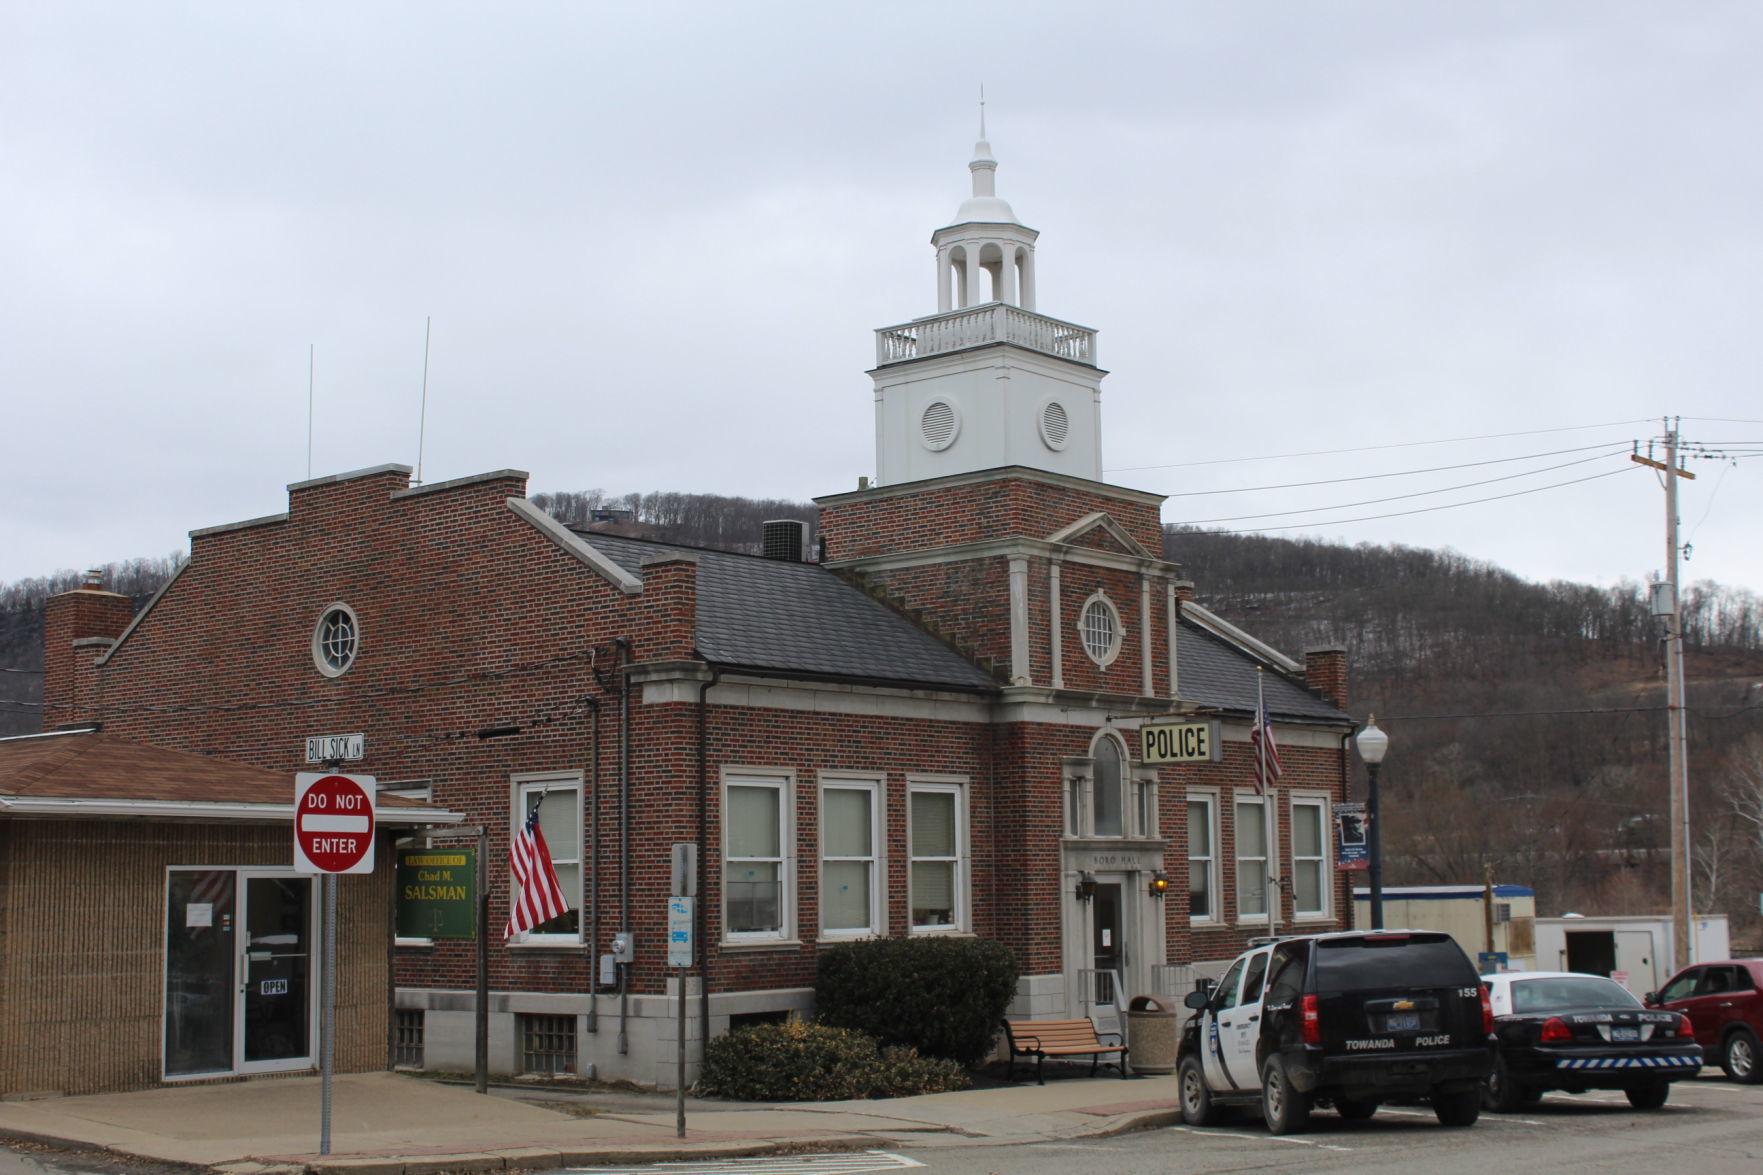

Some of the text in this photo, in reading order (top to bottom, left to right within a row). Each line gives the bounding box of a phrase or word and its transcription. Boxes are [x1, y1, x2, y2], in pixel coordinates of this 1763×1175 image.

[309, 738, 360, 760] BILL SICK LN
[1146, 727, 1206, 759] POLICE
[308, 793, 363, 809] DO NOT
[312, 838, 357, 853] ENTER
[418, 870, 440, 881] Chad
[405, 885, 466, 900] SALSMAN
[263, 981, 286, 993] OPEN
[1458, 988, 1477, 998] 155
[1638, 1013, 1673, 1022] POLICE
[1345, 1034, 1450, 1050] TOWANDA POLICE
